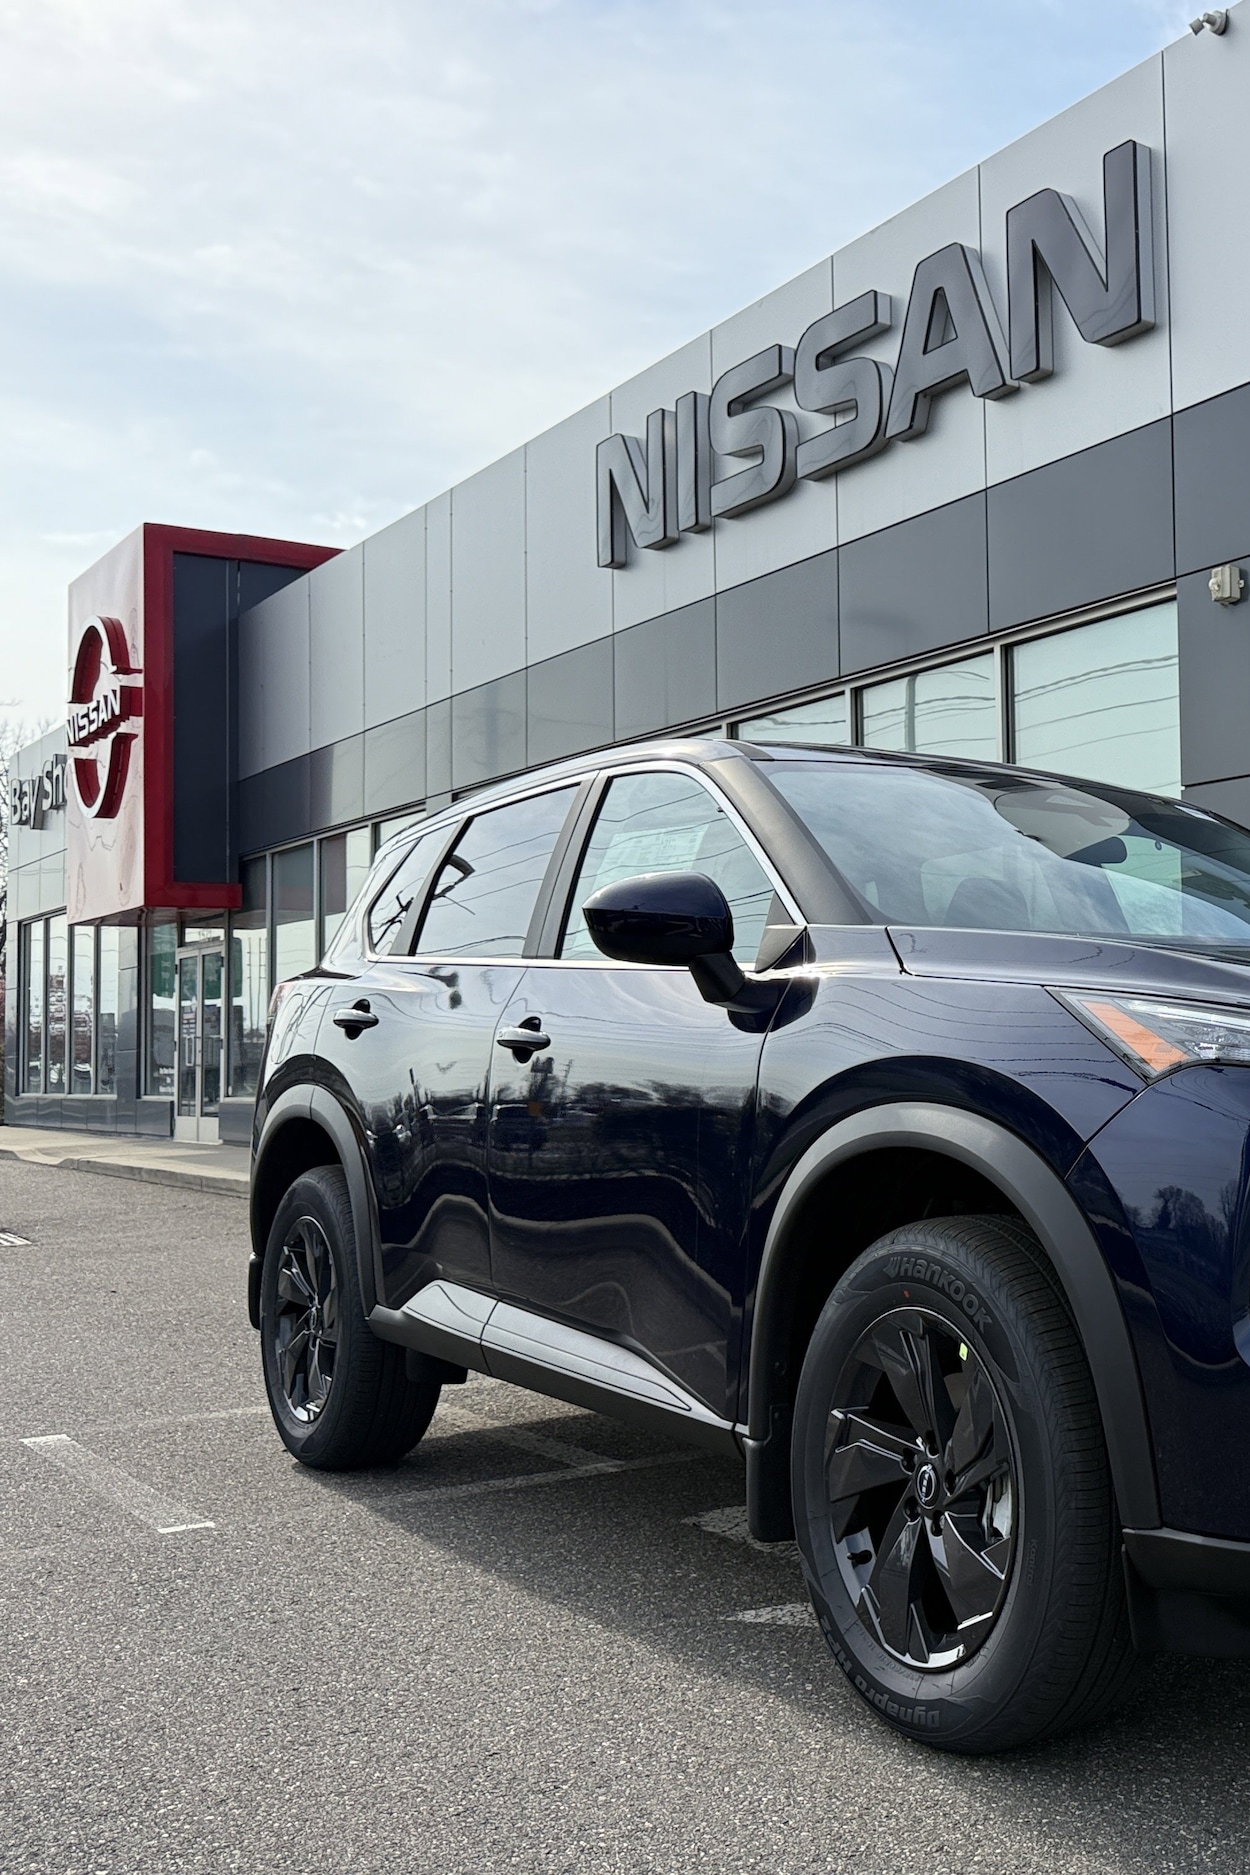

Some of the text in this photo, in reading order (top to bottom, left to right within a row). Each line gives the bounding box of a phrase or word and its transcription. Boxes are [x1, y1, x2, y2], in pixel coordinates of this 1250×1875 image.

[596, 139, 1155, 569] NISSAN
[65, 689, 118, 744] NISSAN
[10, 775, 43, 830] Bay
